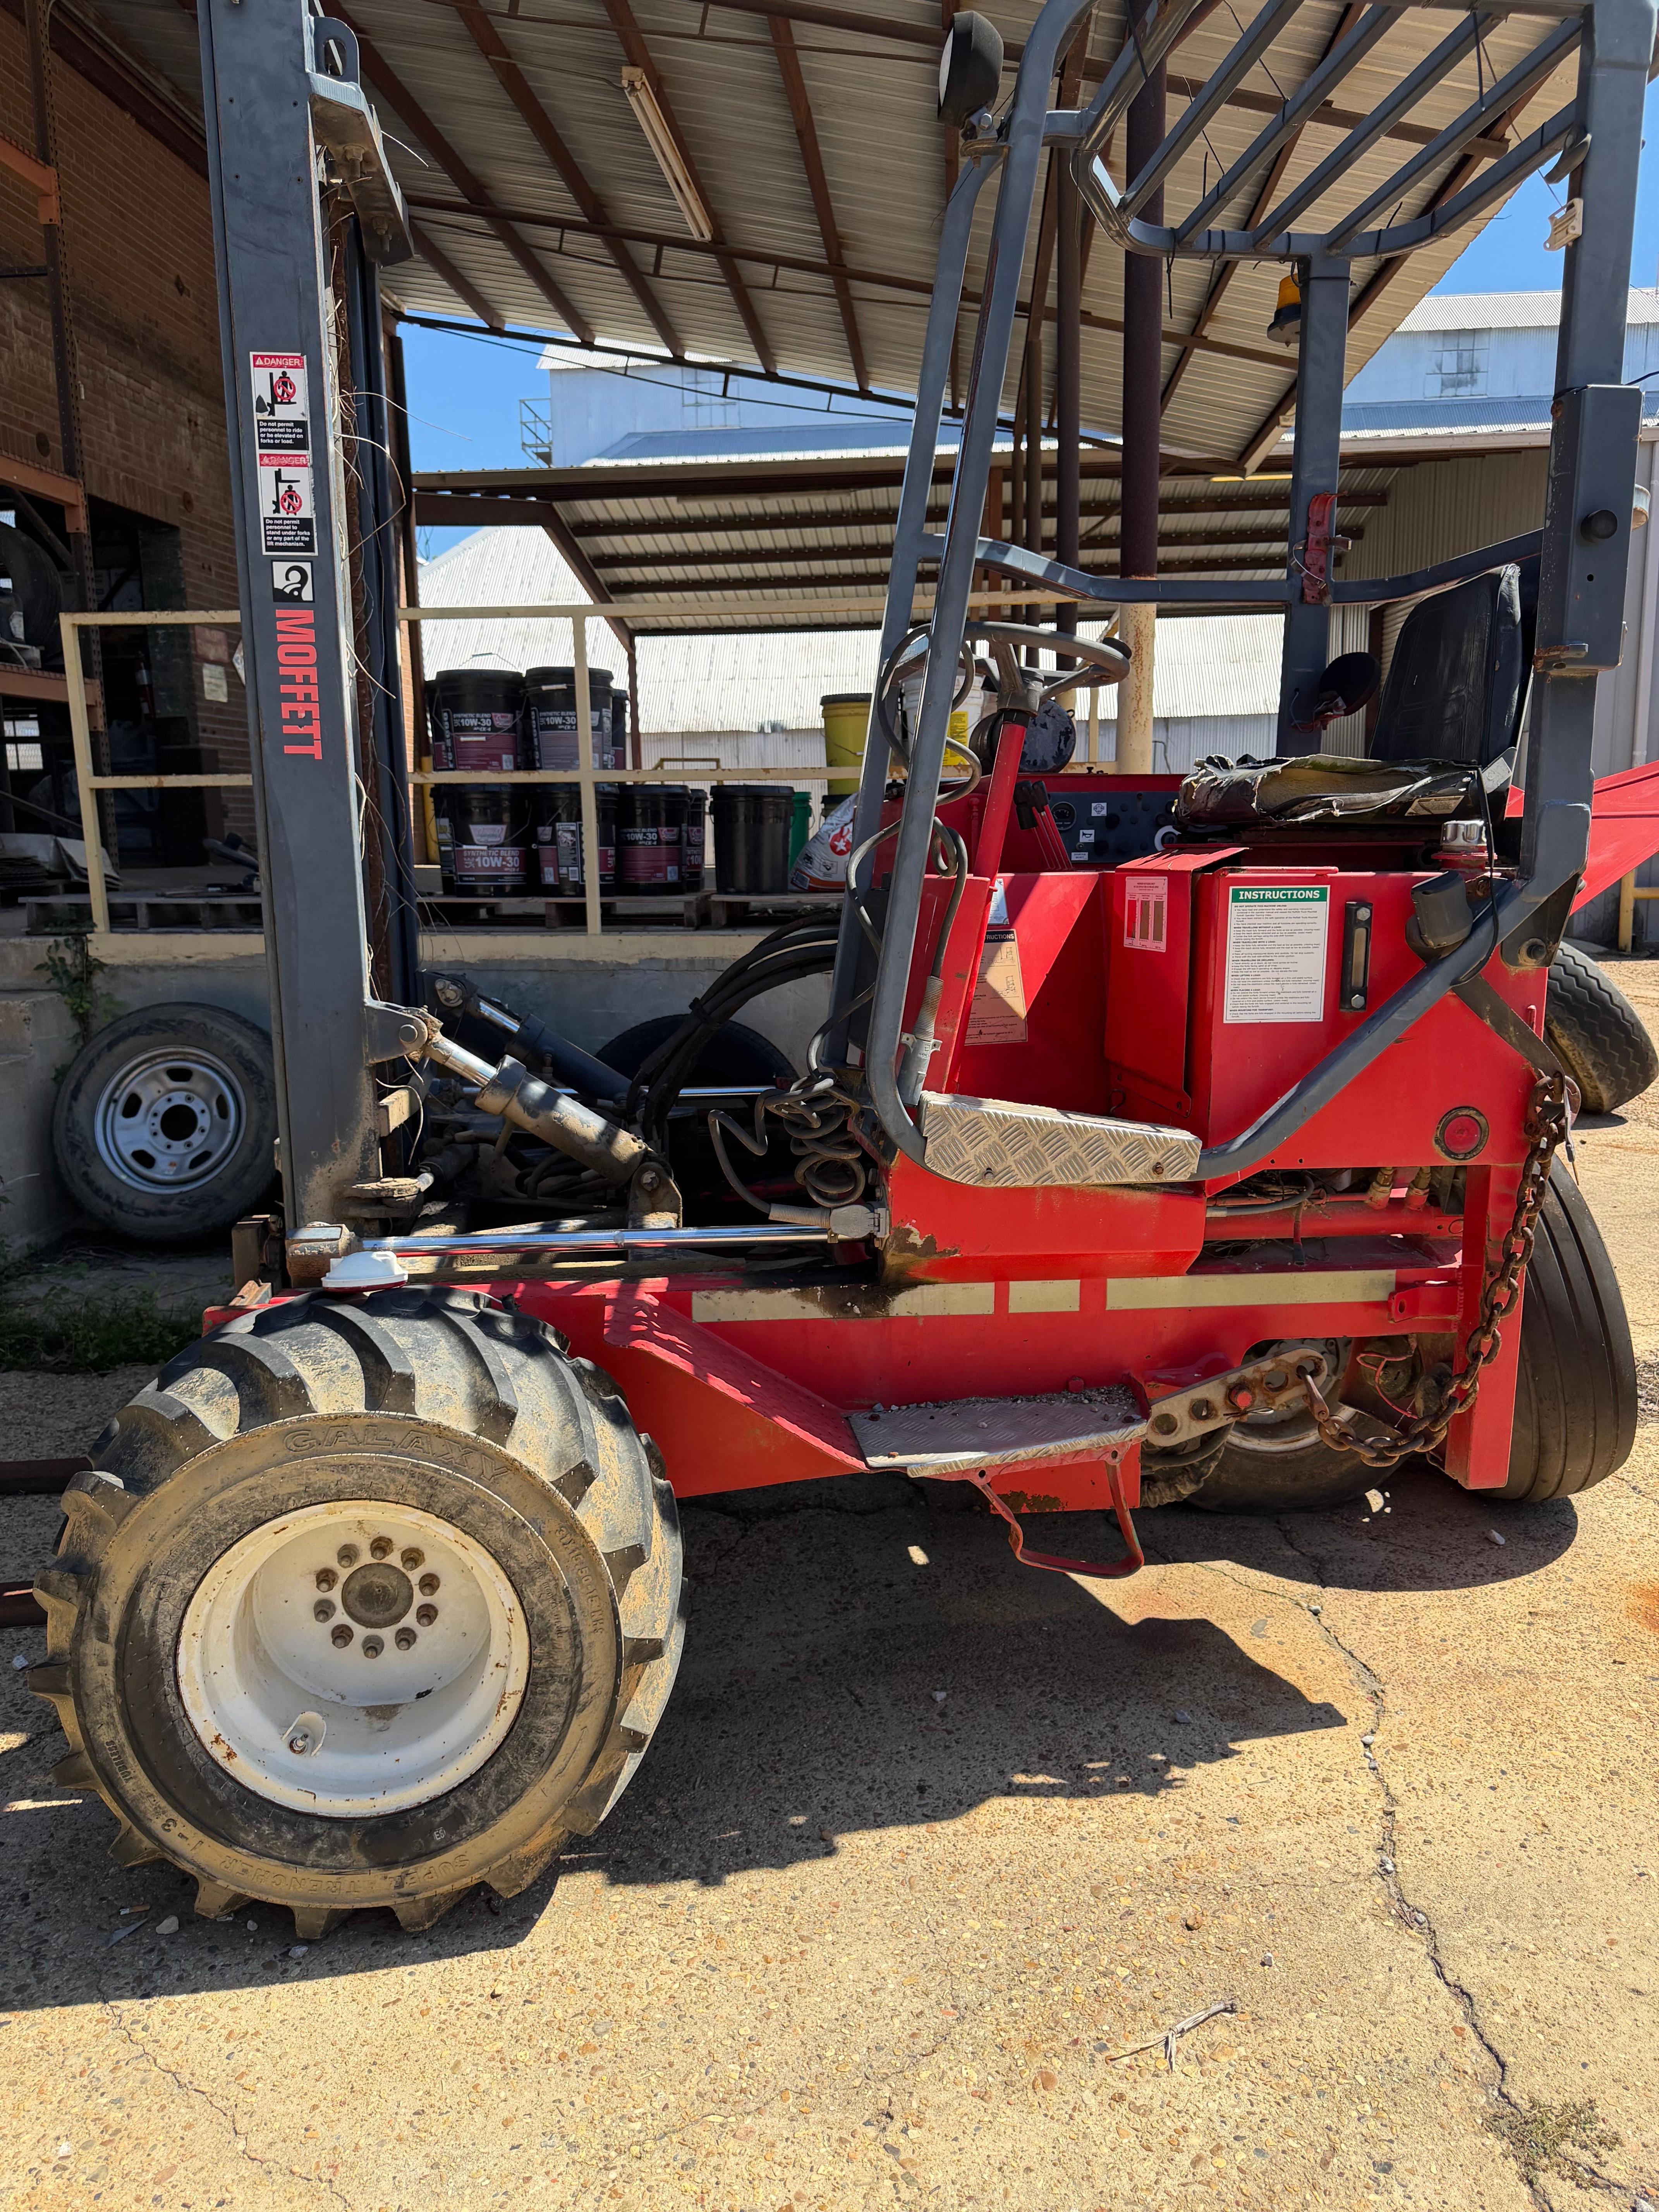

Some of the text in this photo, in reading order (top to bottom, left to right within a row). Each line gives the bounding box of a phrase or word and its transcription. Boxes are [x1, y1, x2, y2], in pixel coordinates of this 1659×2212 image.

[264, 358, 300, 366] DANGER
[276, 610, 322, 759] MOFFETT
[476, 857, 520, 867] 10W-30
[1239, 891, 1320, 899] INSTRUCTIONS
[283, 1425, 510, 1483] GALAXY
[105, 1740, 132, 1785] TUBELESS
[220, 1855, 360, 1896] TRENCHER
[387, 1854, 470, 1890] SUPER
